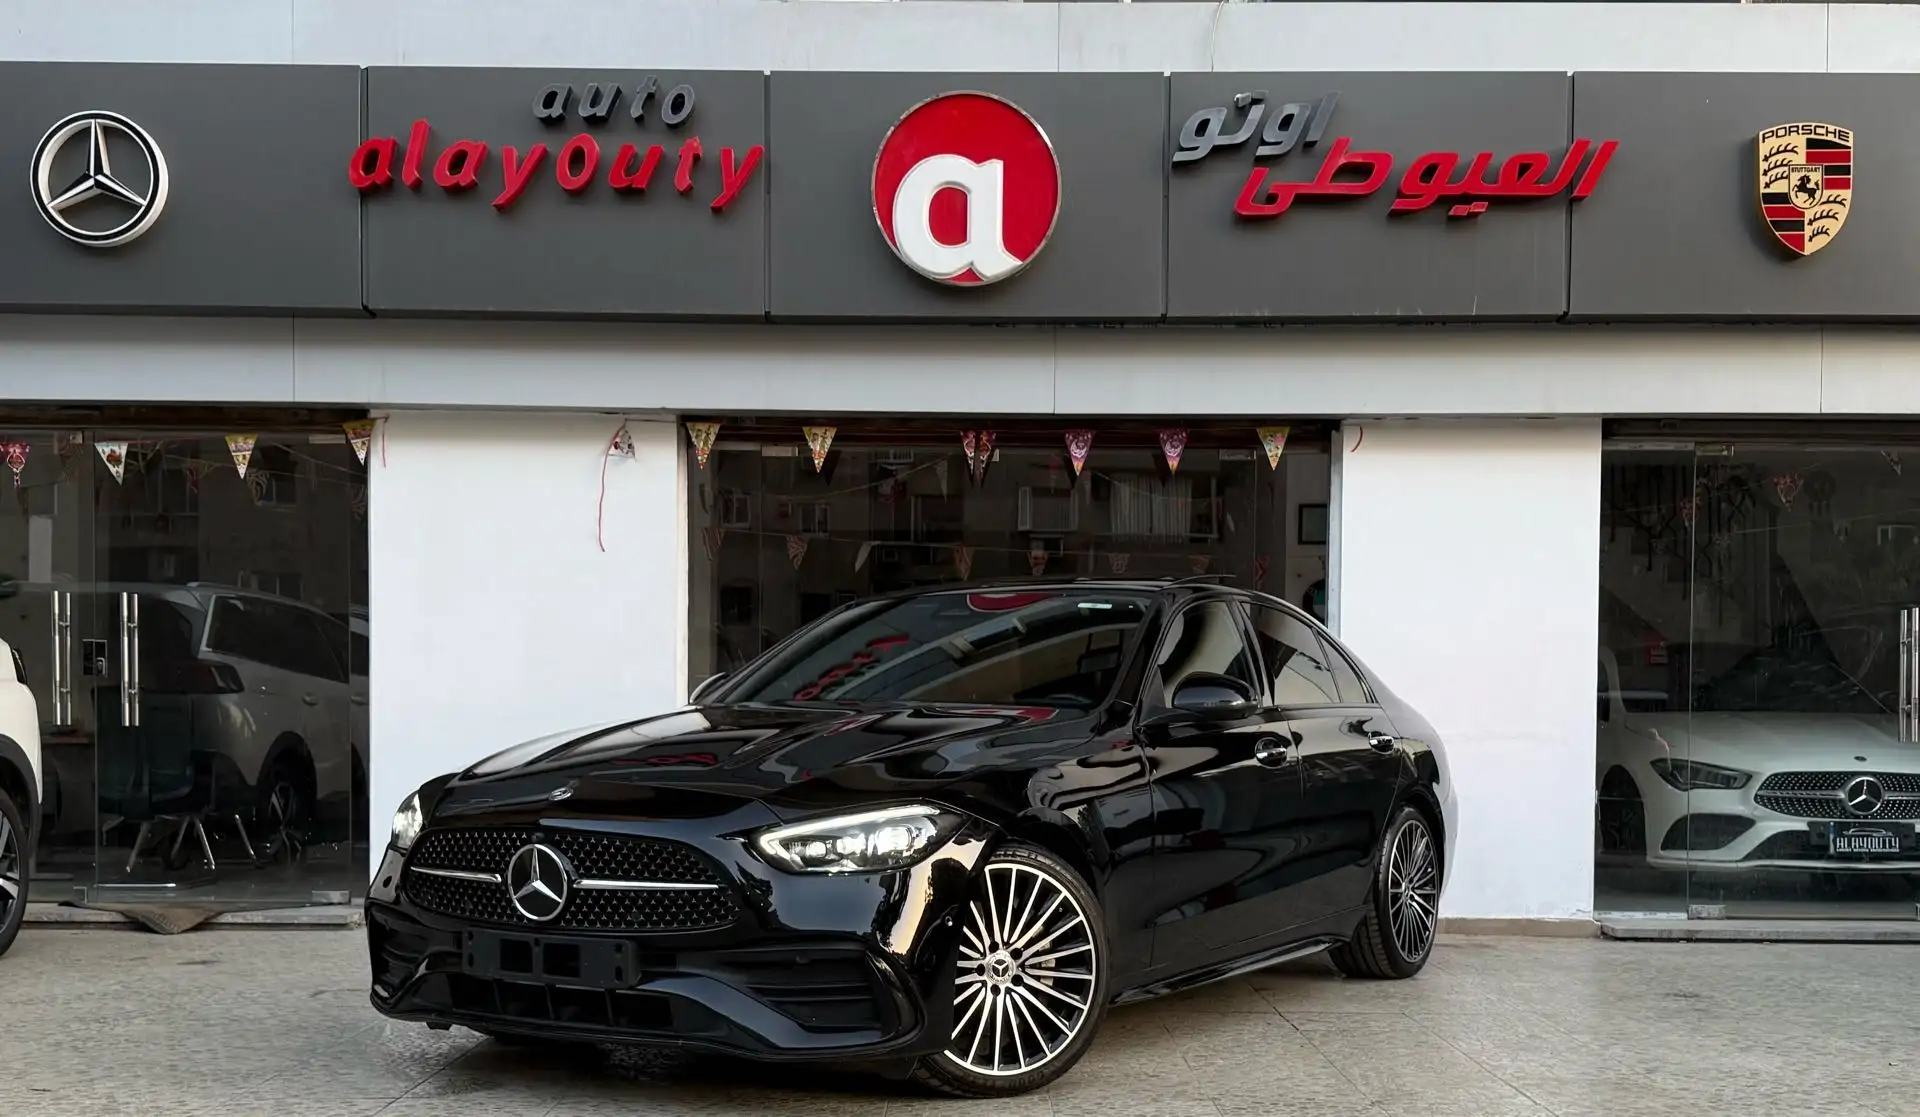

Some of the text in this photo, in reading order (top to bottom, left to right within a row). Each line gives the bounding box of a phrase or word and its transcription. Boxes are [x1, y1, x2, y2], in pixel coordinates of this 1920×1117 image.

[532, 75, 696, 127] auto
[1171, 89, 1342, 168] اوتو
[1762, 124, 1851, 143] PORSCHE
